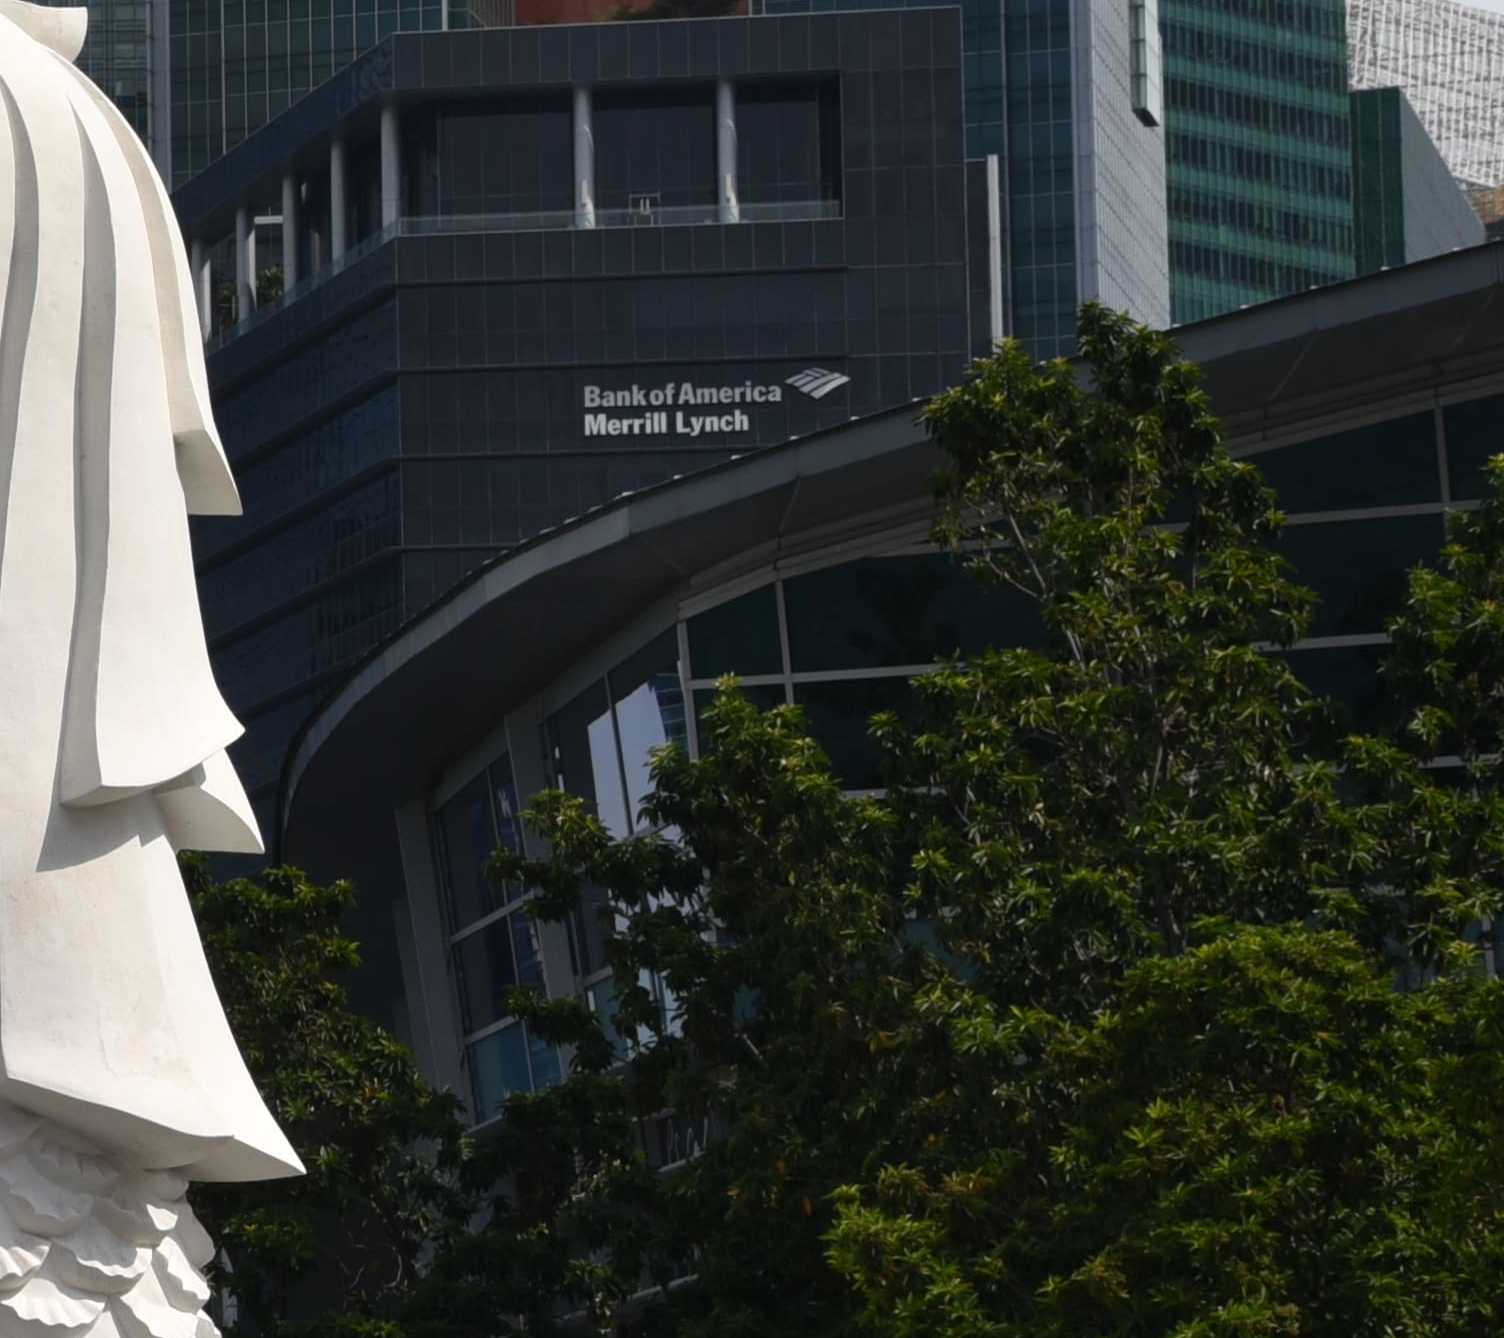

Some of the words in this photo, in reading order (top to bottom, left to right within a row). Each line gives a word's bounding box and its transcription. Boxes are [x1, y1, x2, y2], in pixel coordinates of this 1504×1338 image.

[584, 385, 647, 407] Bank
[649, 383, 676, 406] of
[678, 381, 782, 404] America
[584, 412, 667, 436] Merrill
[675, 409, 749, 436] Lynch
